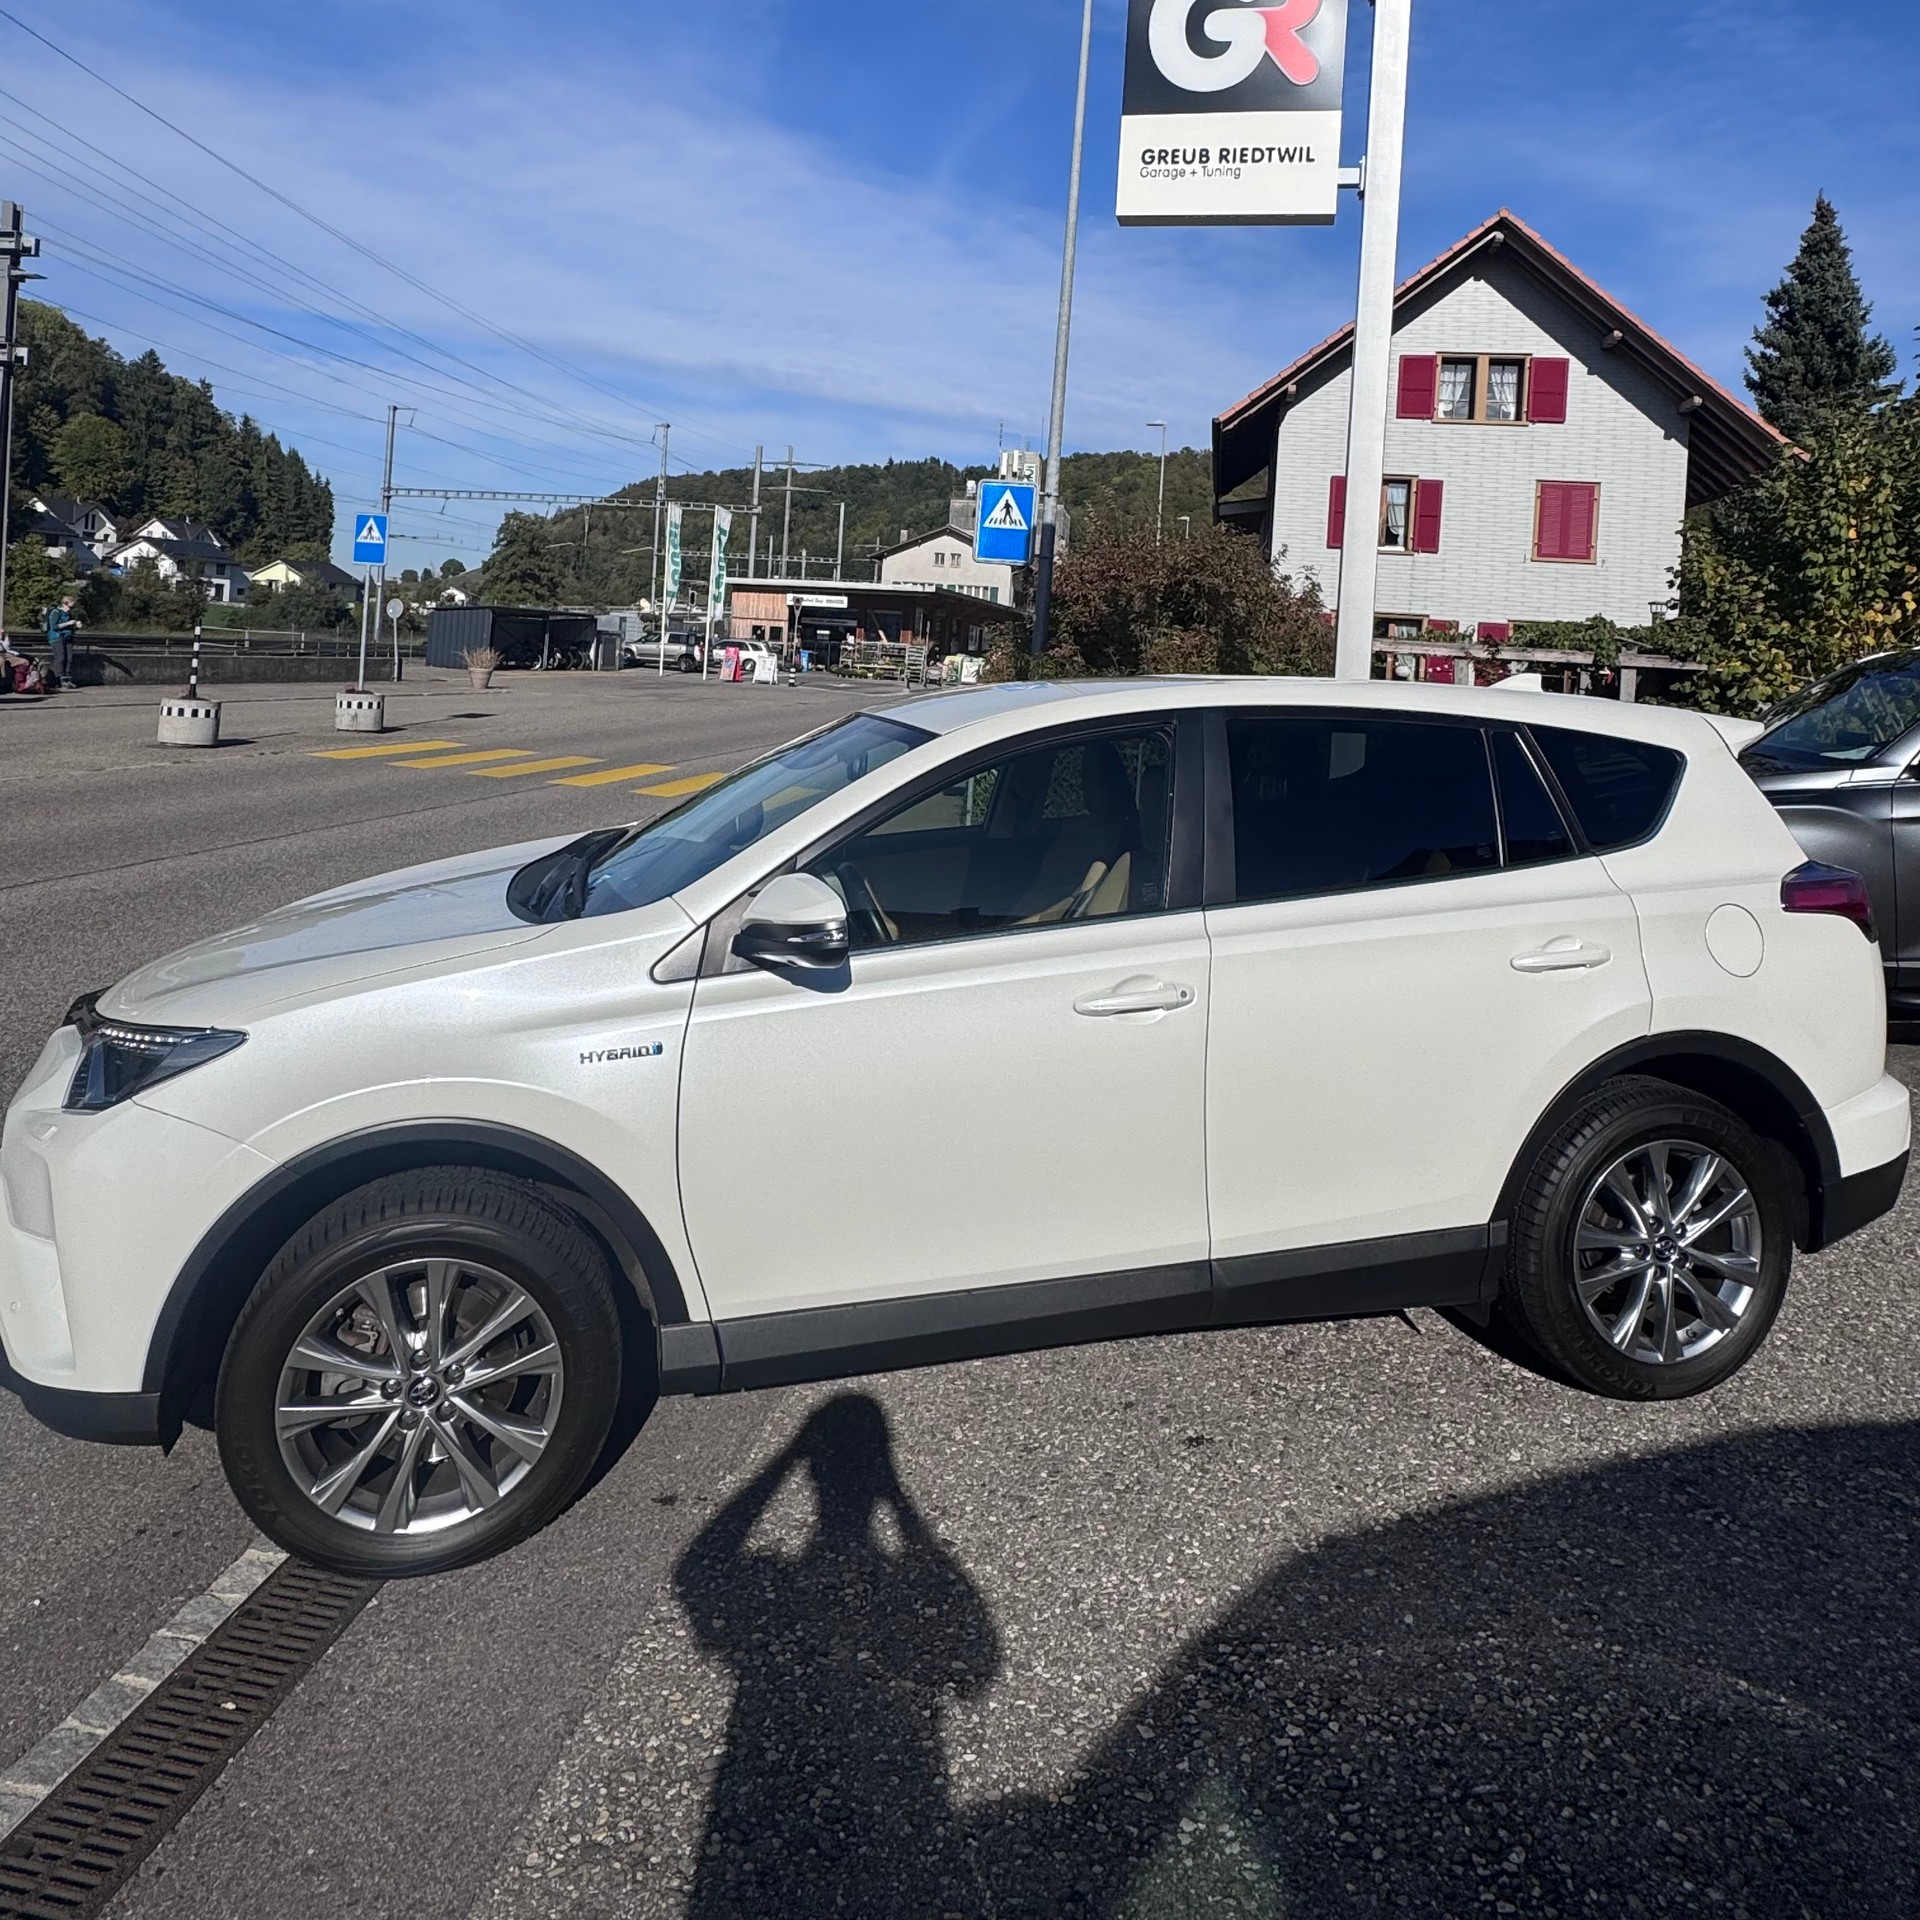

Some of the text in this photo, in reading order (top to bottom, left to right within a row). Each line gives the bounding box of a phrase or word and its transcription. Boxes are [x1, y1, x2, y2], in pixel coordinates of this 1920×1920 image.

[1140, 146, 1315, 165] GREUB RIEDTWIL
[1140, 166, 1186, 180] Garage
[1201, 165, 1241, 179] Tuning
[580, 1045, 650, 1064] HYBRID
